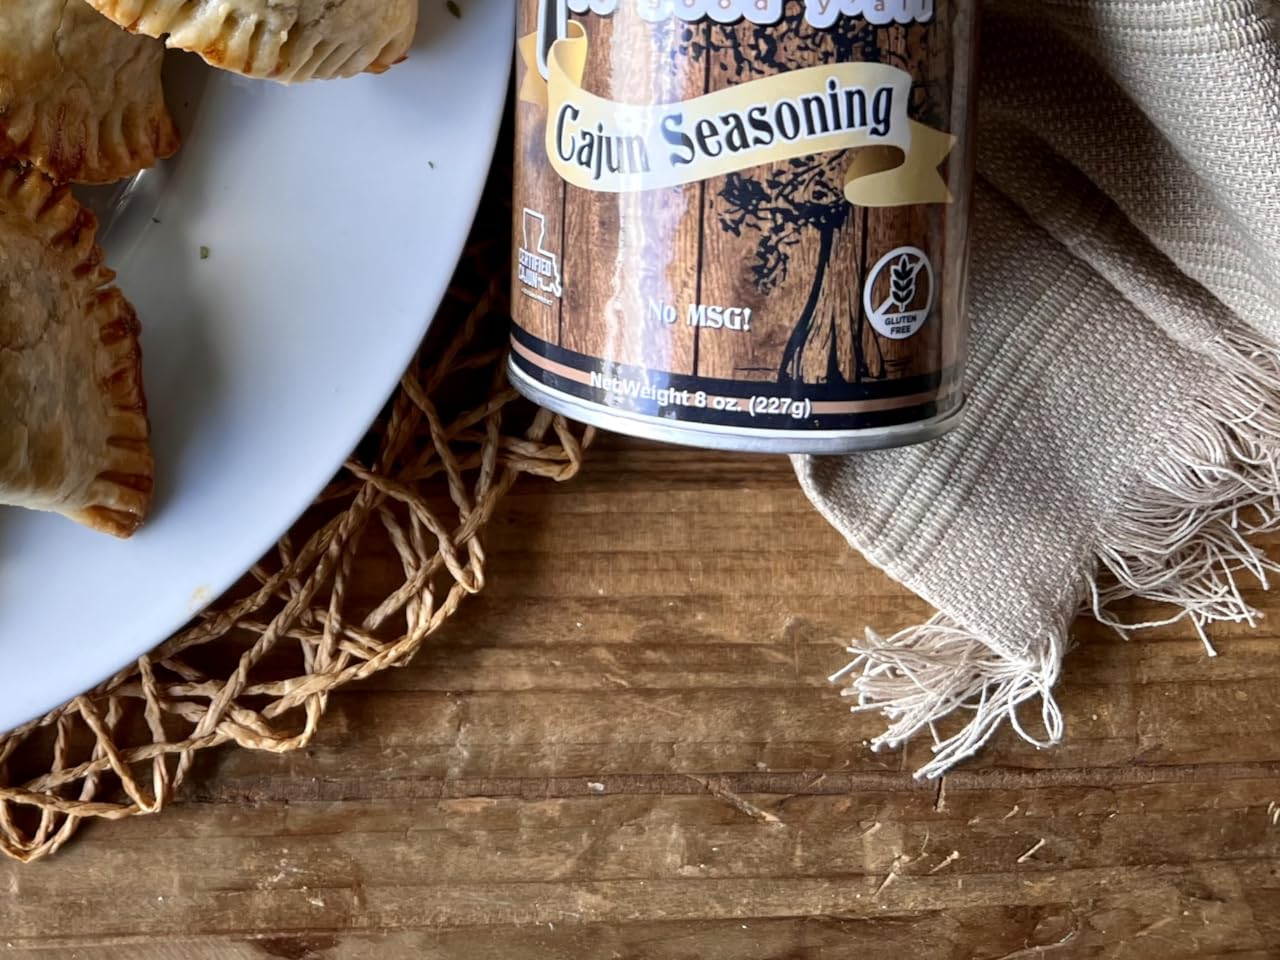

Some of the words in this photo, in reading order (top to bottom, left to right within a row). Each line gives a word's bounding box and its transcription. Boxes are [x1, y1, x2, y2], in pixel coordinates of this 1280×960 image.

[556, 104, 651, 181] Cajun
[660, 79, 894, 166] Seasoning
[648, 299, 676, 325] No
[686, 303, 752, 332] MSG!
[884, 314, 918, 326] GLUTEN
[890, 325, 912, 335] FREE
[590, 371, 620, 393] Net
[621, 379, 689, 410] Weight
[695, 392, 707, 408] 8
[712, 398, 742, 412] oz.
[748, 397, 813, 419] (227g)
